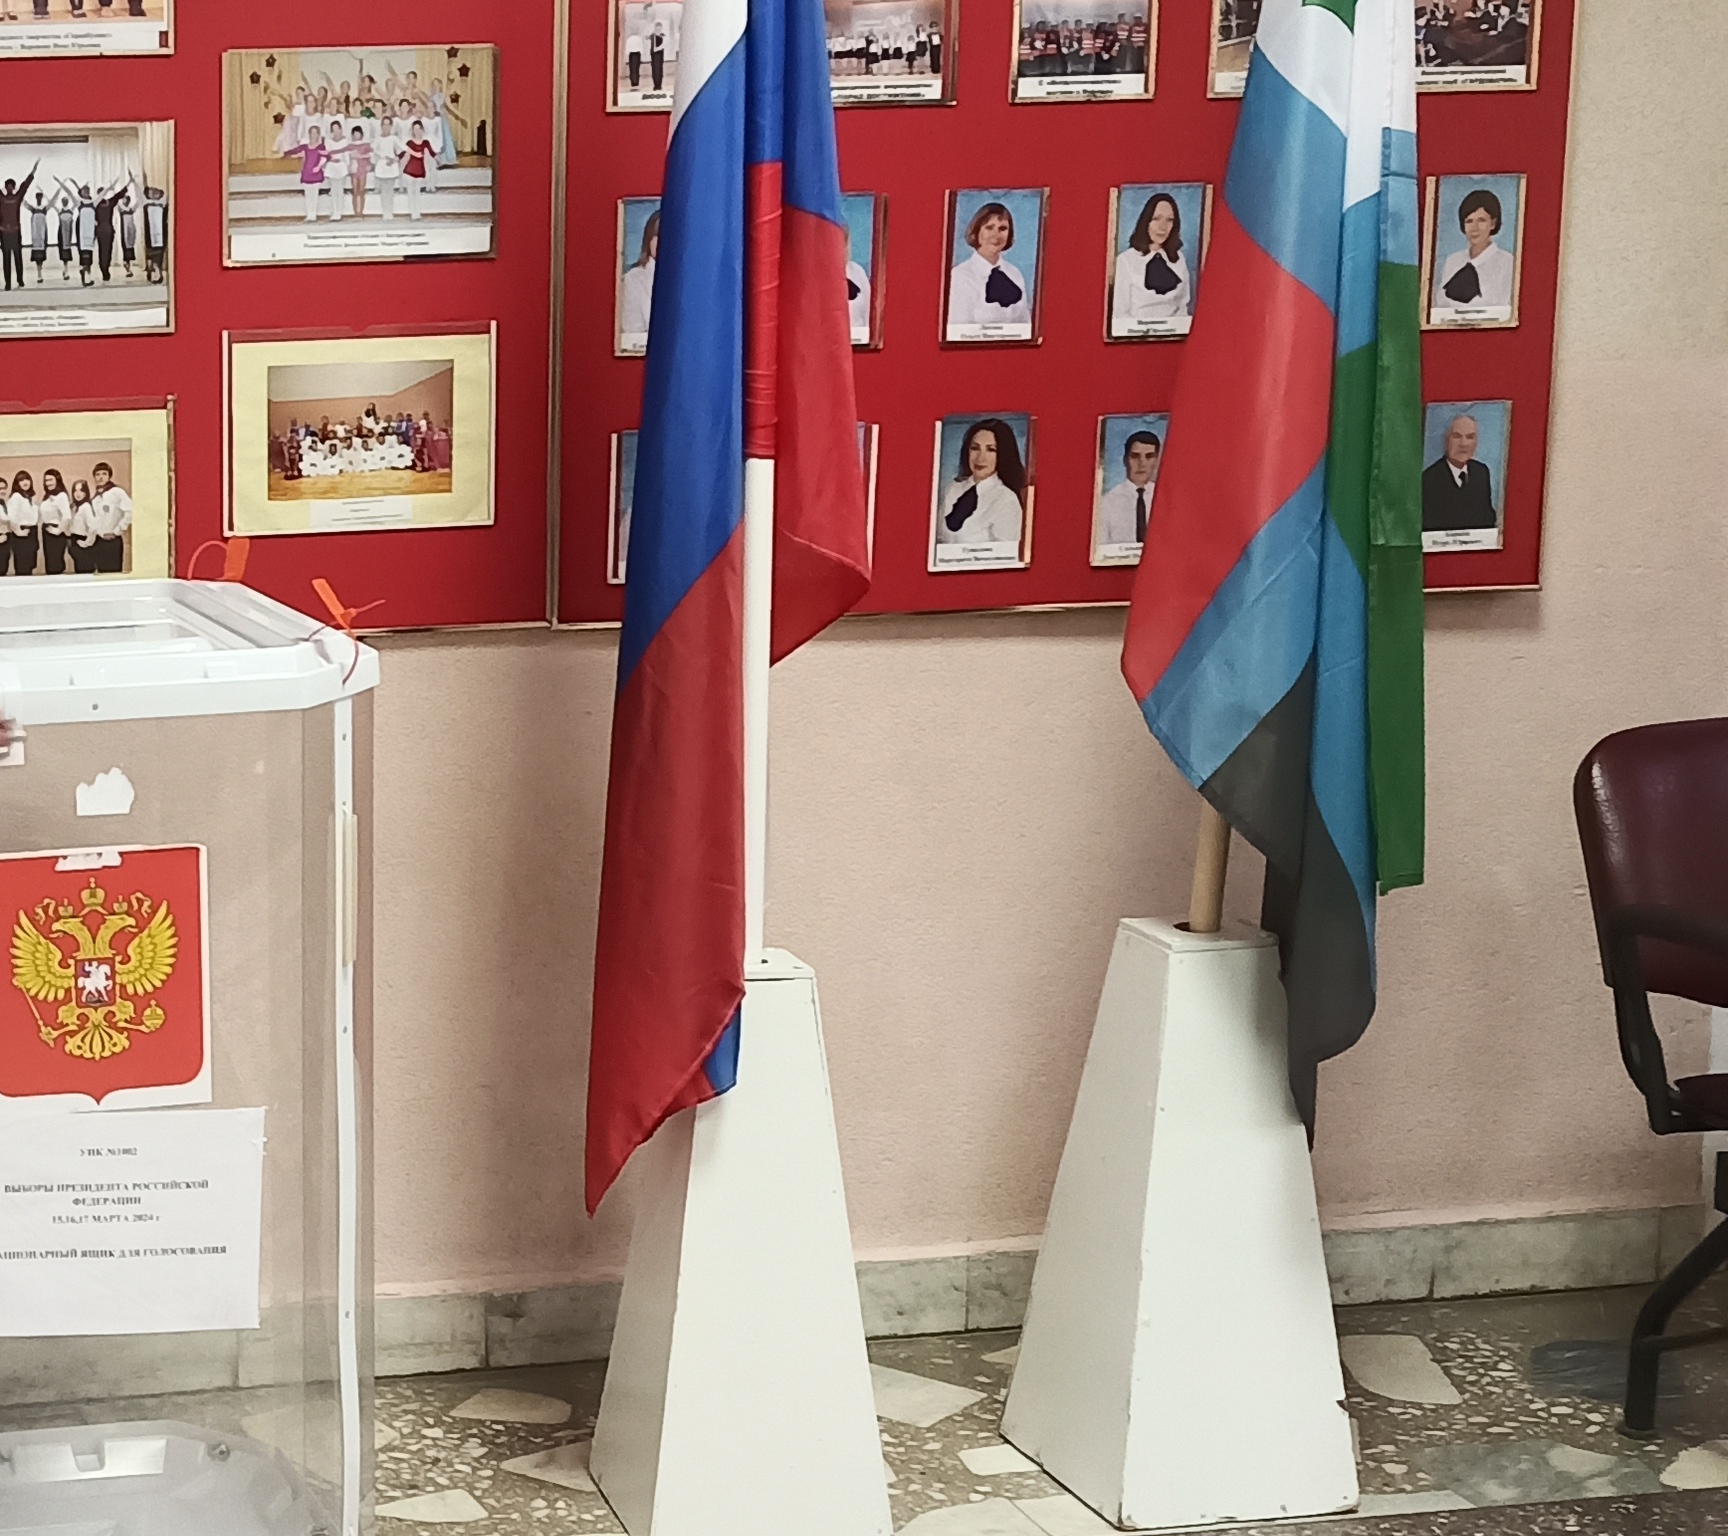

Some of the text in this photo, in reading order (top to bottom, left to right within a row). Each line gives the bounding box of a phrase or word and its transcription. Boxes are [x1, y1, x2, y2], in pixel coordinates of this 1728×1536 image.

[4, 1179, 209, 1194] ВЫБОРЫ ПРЕЗИДЕНТА РОССИЙСКОЙ
[72, 1196, 142, 1207] ФЕДЕРАЦИИ
[92, 1214, 130, 1224] МАРТА
[80, 1248, 117, 1260] ЯЩИК
[143, 1245, 228, 1259] ГОЛОСОВАНИЯ
